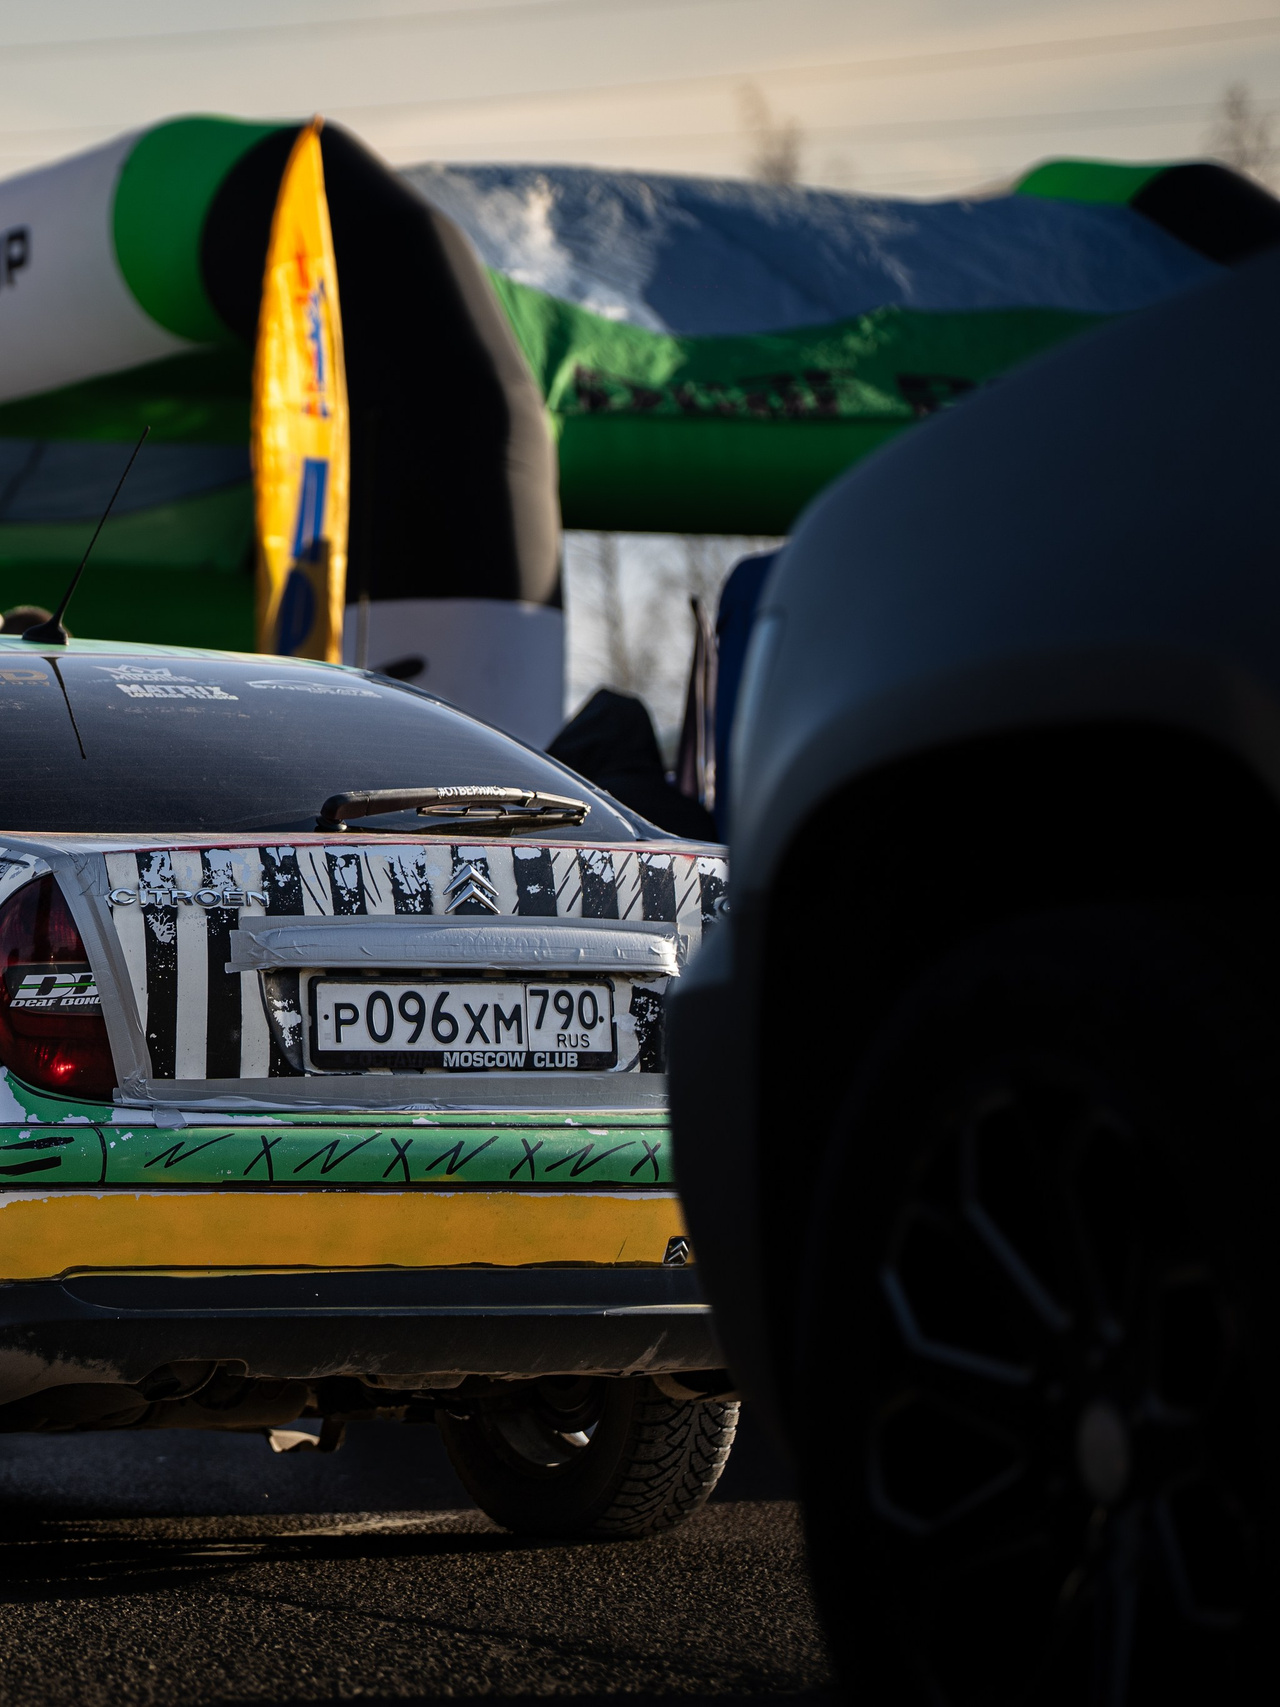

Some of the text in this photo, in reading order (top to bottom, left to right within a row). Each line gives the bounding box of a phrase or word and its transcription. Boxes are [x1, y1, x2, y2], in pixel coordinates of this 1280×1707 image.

[116, 683, 230, 696] MATRIX
[108, 887, 269, 907] CITROËN
[334, 989, 598, 1044] P096XM 790
[557, 1034, 591, 1048] RUS
[443, 1052, 526, 1068] MOSCOW
[533, 1052, 579, 1068] CLUB
